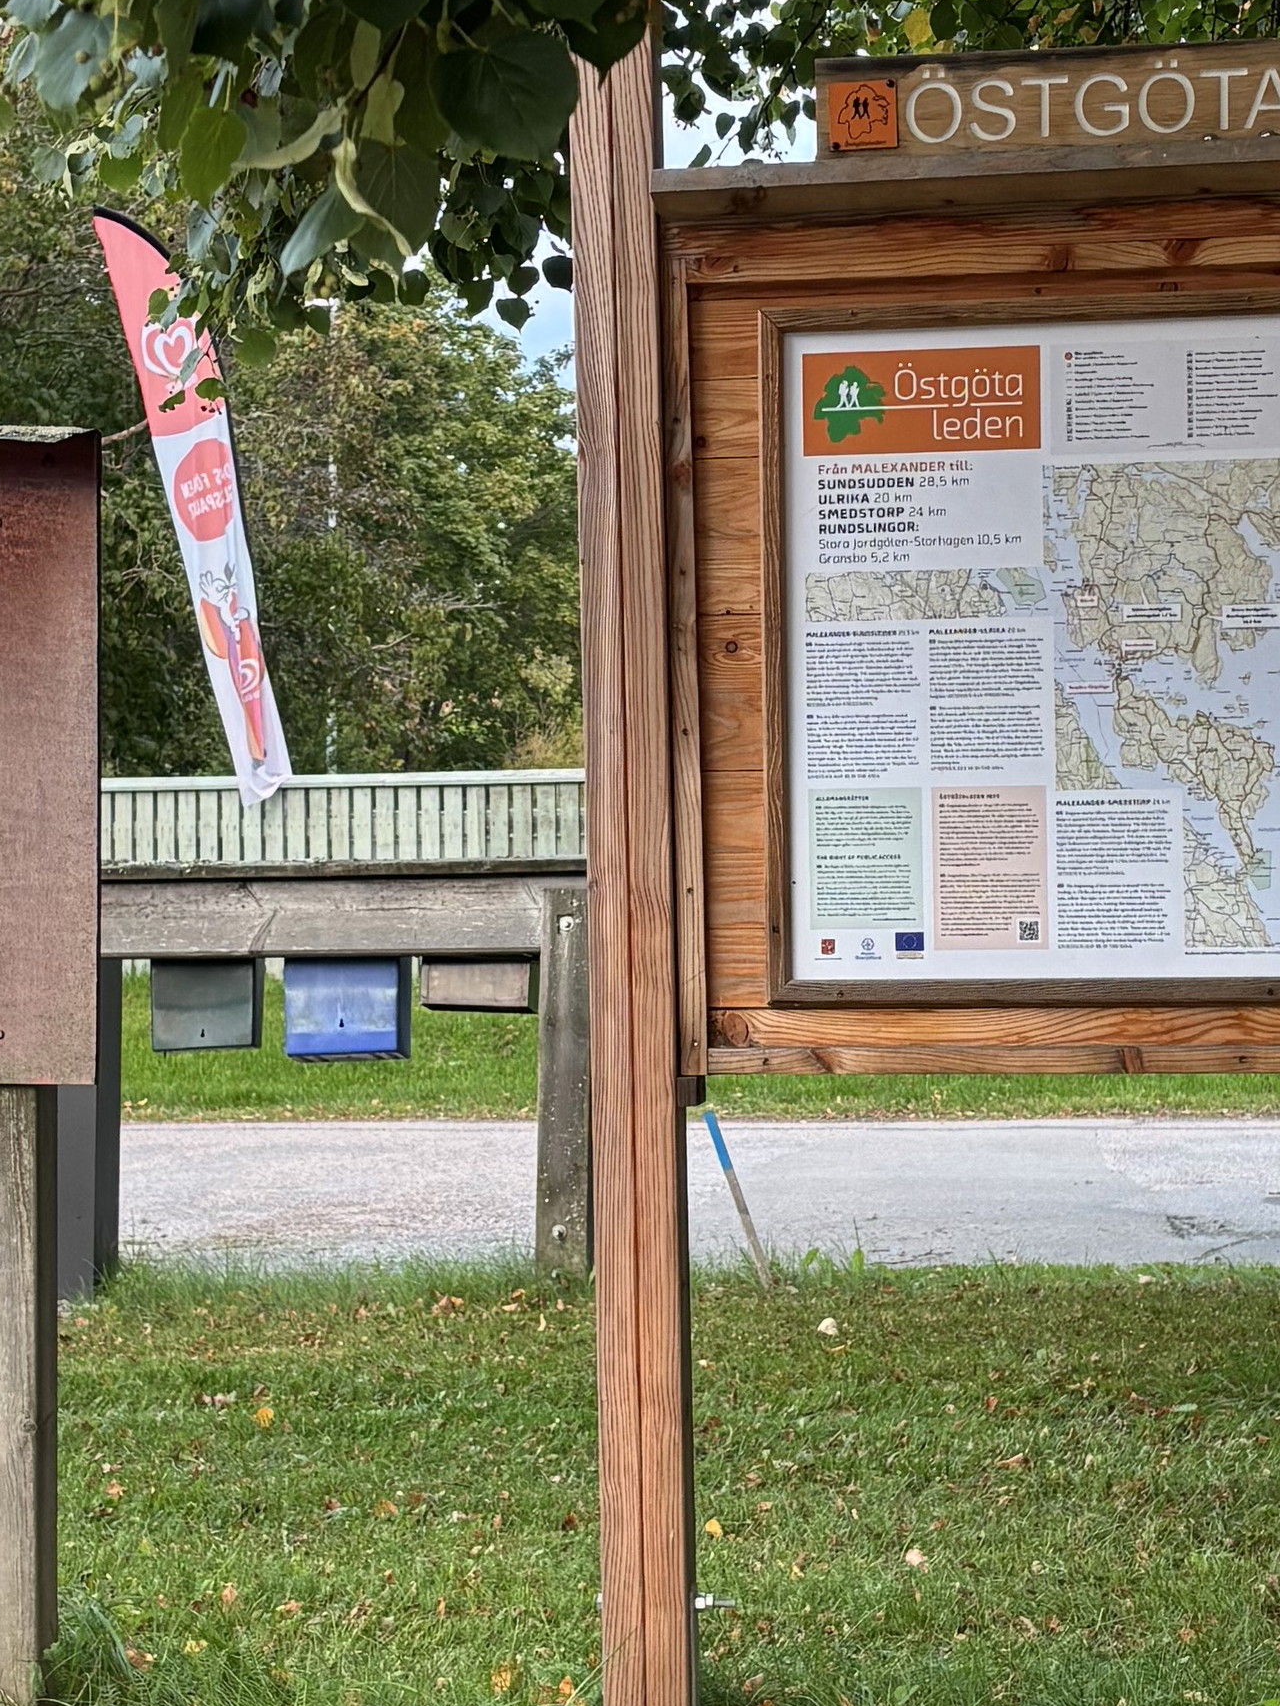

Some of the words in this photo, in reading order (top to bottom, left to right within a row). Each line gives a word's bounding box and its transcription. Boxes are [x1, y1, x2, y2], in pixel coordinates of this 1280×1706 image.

[894, 362, 1023, 407] Östgöta
[933, 408, 1023, 440] leden
[818, 462, 848, 475] Från
[851, 461, 946, 474] MALEXANDER
[949, 460, 973, 472] till:
[818, 477, 915, 490] SUNDSUDDEN
[919, 476, 948, 488] 28,5
[951, 476, 970, 486] km
[818, 493, 870, 505] ULRIKA
[874, 492, 890, 503] 20
[894, 492, 912, 503] km
[818, 507, 905, 520] SMEDSTORP
[908, 506, 924, 517] 24
[928, 506, 947, 517] km
[818, 521, 920, 535] RUNDSLINGOR:
[819, 536, 850, 549] Stora
[977, 533, 1002, 546] 10,5
[1005, 533, 1022, 544] km
[818, 552, 867, 564] Gransbo
[870, 552, 890, 564] 5,2
[893, 551, 910, 562] km
